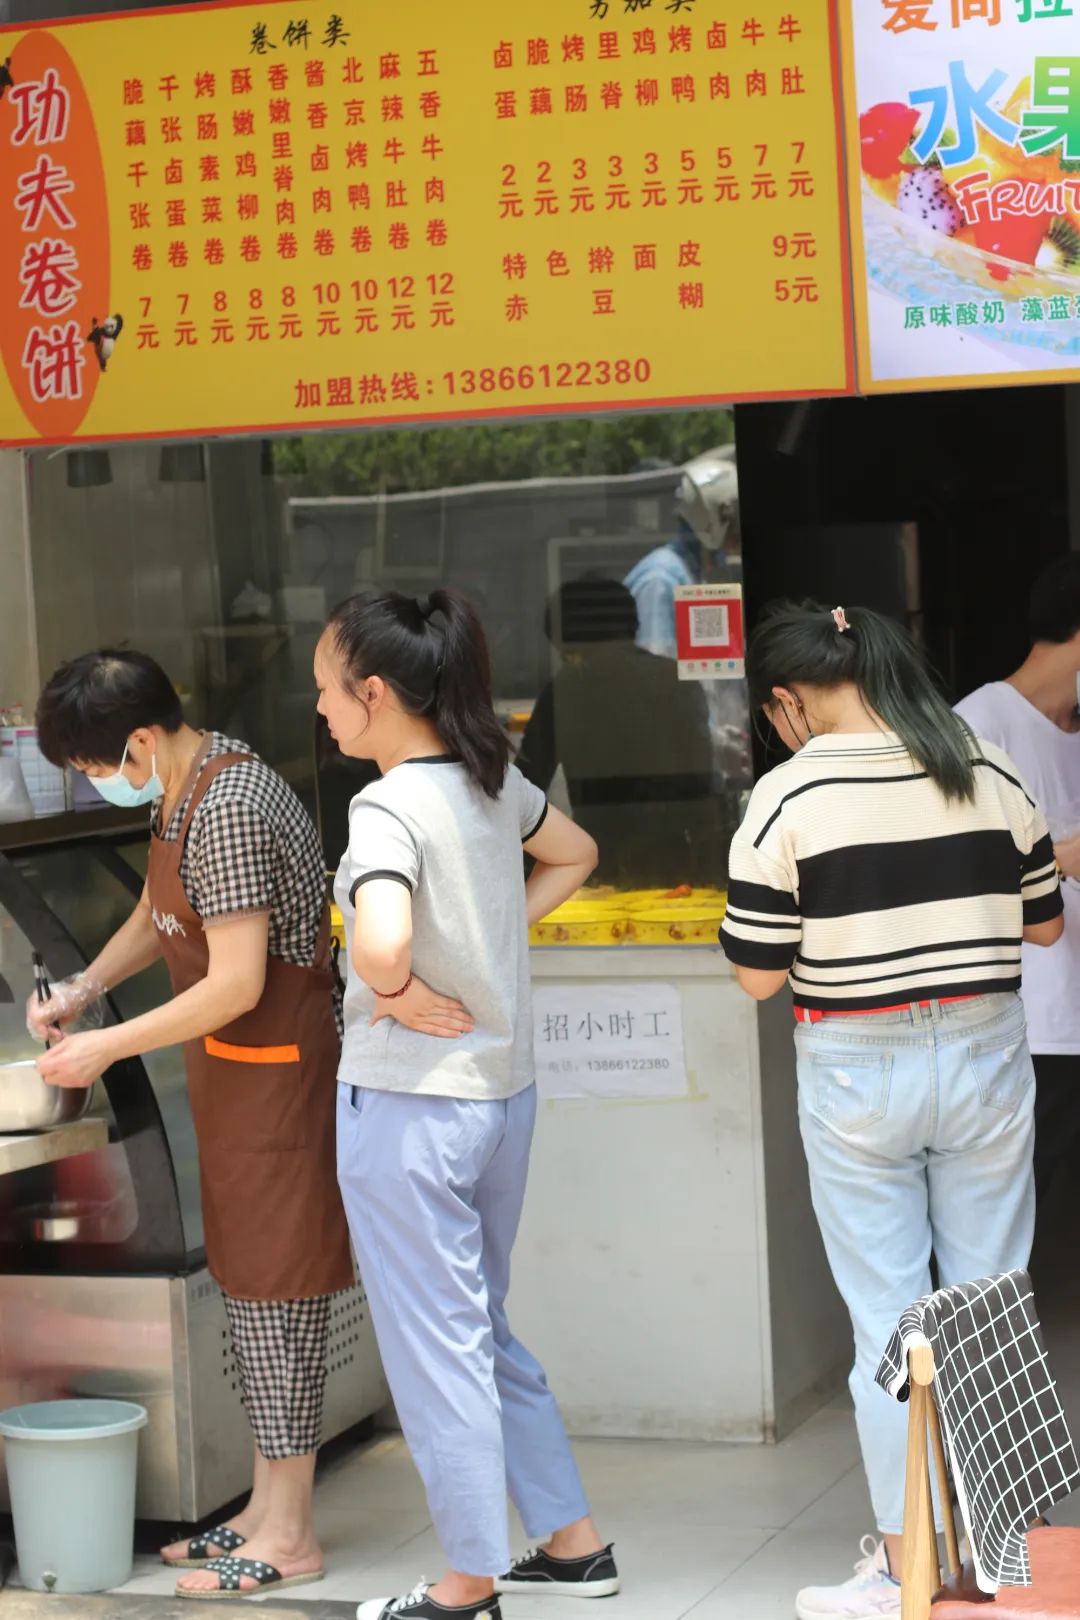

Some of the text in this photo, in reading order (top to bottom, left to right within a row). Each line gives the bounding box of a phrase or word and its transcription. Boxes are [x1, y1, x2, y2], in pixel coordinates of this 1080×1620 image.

[249, 14, 351, 54] 卷饼类
[706, 21, 731, 99] 卤肉
[741, 19, 767, 97] 牛肉
[779, 15, 805, 96] 牛肚
[492, 40, 517, 120] 卤蛋
[526, 37, 553, 115] 脆藕
[560, 34, 588, 113] 烤肠
[598, 31, 623, 110] 里脊
[632, 27, 659, 104] 鸡柳
[667, 25, 696, 102] 烤鸭
[123, 78, 153, 272] 脆藕千张卷
[159, 75, 189, 269] 千张卤蛋卷
[193, 71, 224, 265] 烤肠素菜卷
[230, 66, 261, 262] 酥嫩鸡柳卷
[268, 63, 297, 260] 香嫩里脊肉卷
[304, 59, 335, 257] 酱香卤肉卷
[342, 57, 372, 253] 北京烤鸭卷
[378, 52, 409, 250] 麻辣牛肚卷
[416, 48, 448, 247] 五香牛肉卷
[715, 146, 740, 203] 5元
[752, 143, 777, 200] 7元
[789, 141, 814, 197] 7元
[501, 163, 525, 218] 2元
[534, 159, 560, 215] 2元
[570, 158, 595, 213] 3元
[605, 155, 630, 209] 3元
[641, 151, 667, 208] 3元
[678, 150, 704, 205] 5元
[10, 69, 85, 401] 功夫卷饼
[502, 240, 701, 279] 特色擀面皮
[772, 232, 817, 258] 9元
[211, 290, 235, 344] 8元
[248, 288, 270, 341] 8元
[282, 285, 303, 339] 8元
[313, 281, 341, 336] 10元
[351, 278, 379, 333] 10元
[388, 275, 416, 330] 12元
[426, 271, 455, 328] 12元
[507, 282, 704, 321] 赤豆糊
[774, 276, 818, 303] 5元
[904, 295, 1080, 329] 原味酸奶 藻蓝
[137, 296, 160, 349] 7元
[175, 292, 198, 346] 7元
[543, 1010, 671, 1042] 招小时工
